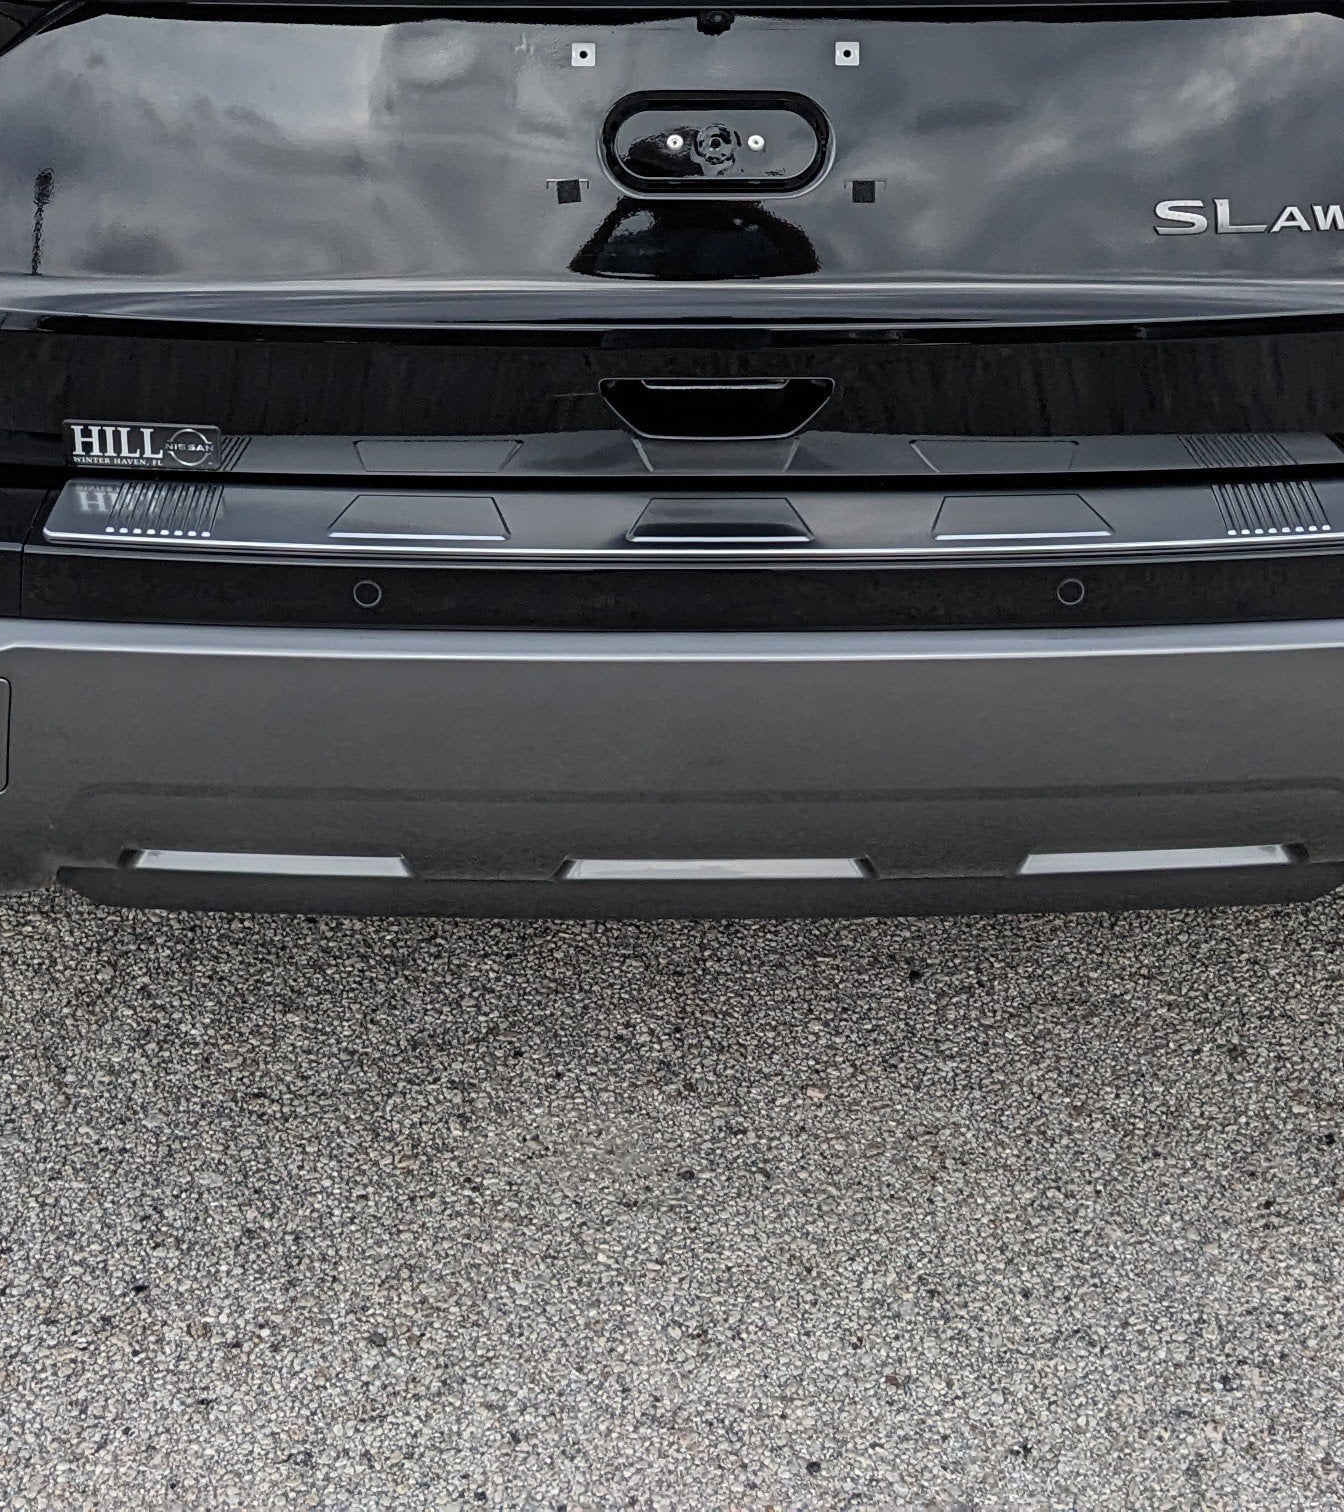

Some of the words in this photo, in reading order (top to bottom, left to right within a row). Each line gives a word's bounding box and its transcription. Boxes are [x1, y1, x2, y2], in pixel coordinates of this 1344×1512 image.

[70, 425, 164, 459] HILL
[165, 442, 214, 452] NISSAN
[73, 456, 111, 464] WINTER
[114, 458, 150, 466] HAVEN,
